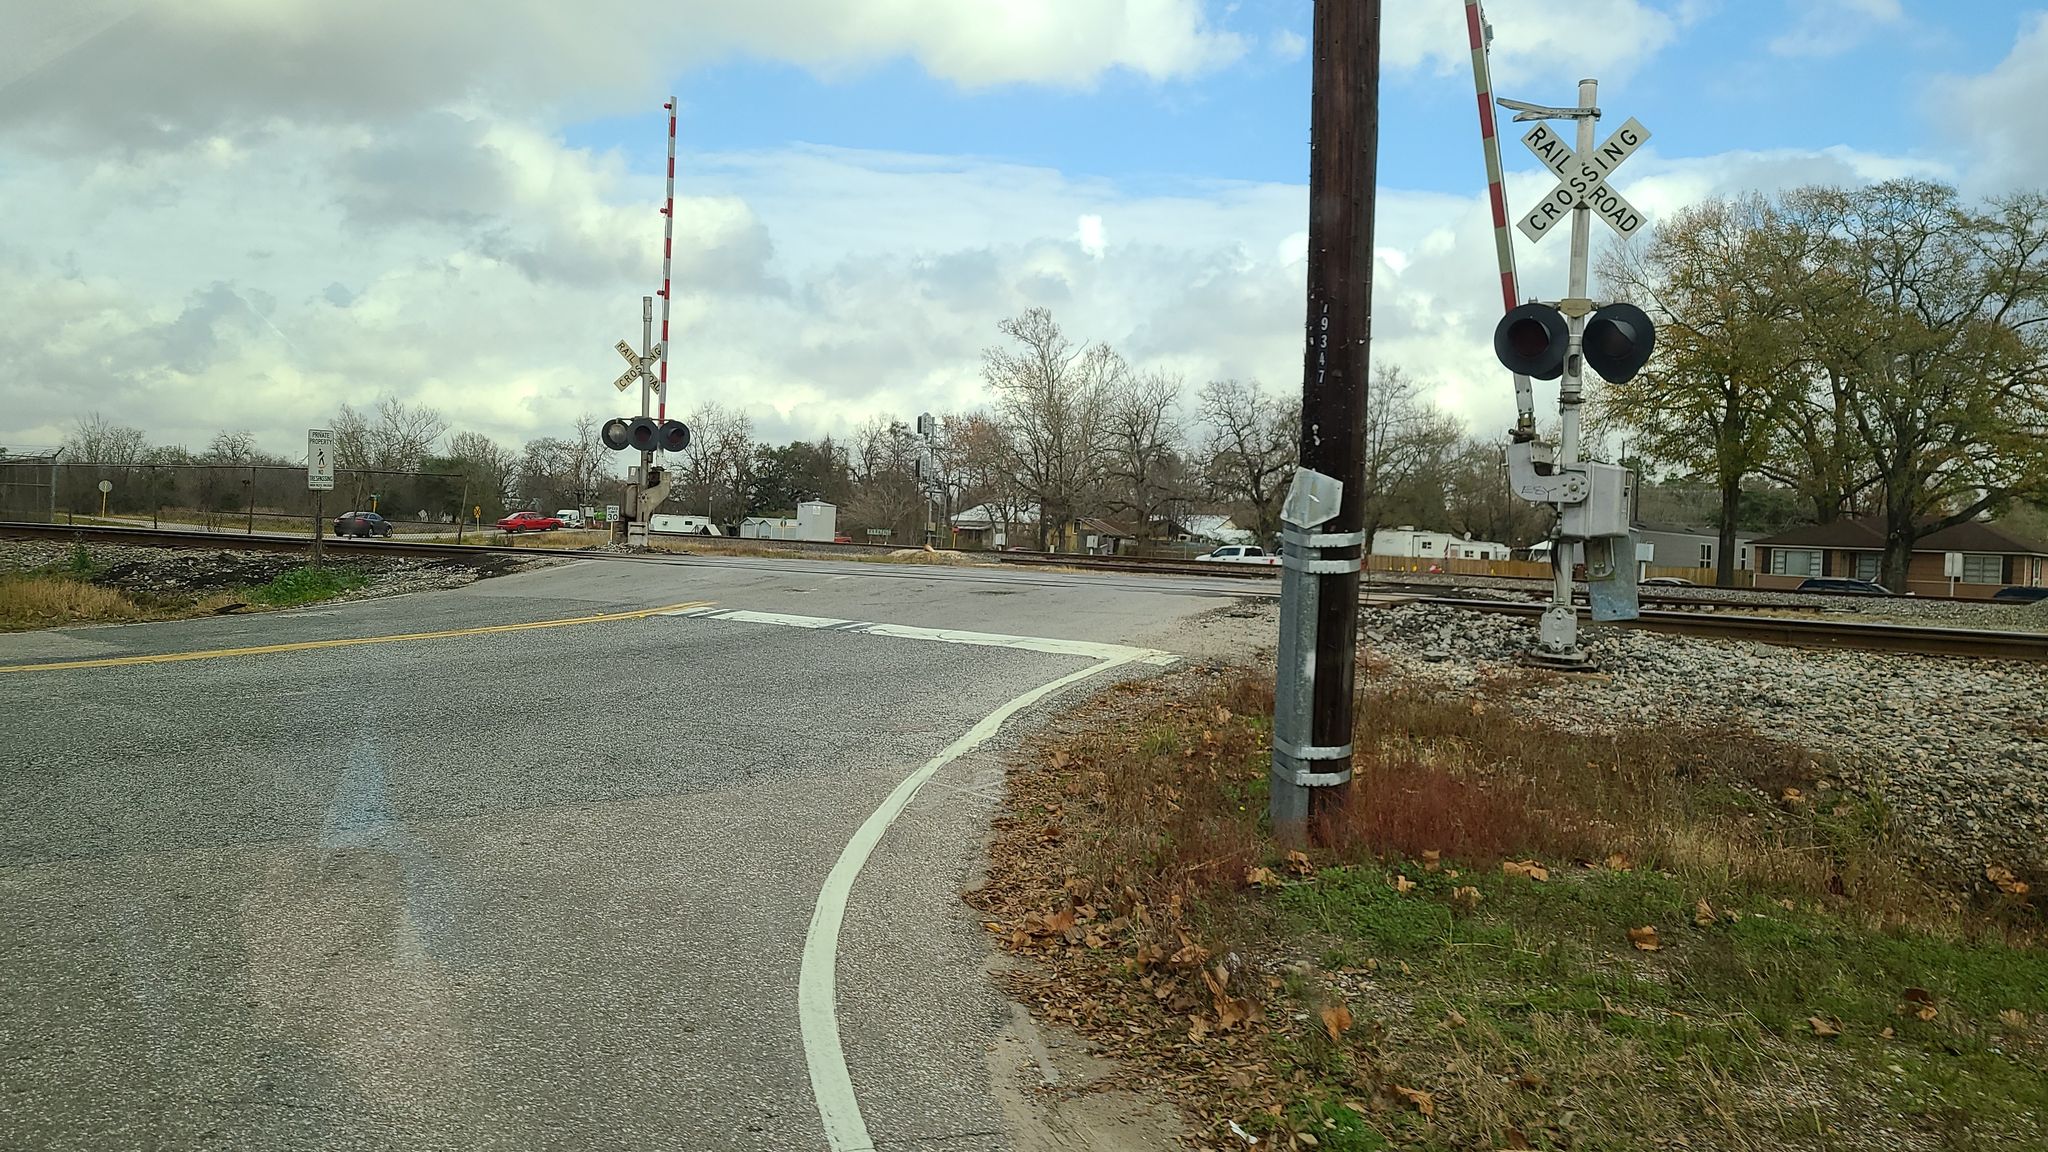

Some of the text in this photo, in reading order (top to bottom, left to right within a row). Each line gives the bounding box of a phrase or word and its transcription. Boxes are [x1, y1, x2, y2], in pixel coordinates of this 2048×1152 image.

[1527, 126, 1638, 232] RAIL ROAD
[1529, 129, 1638, 231] CROSSING
[617, 342, 636, 364] RAIL
[1318, 304, 1329, 383] 19347
[607, 513, 618, 521] 30
